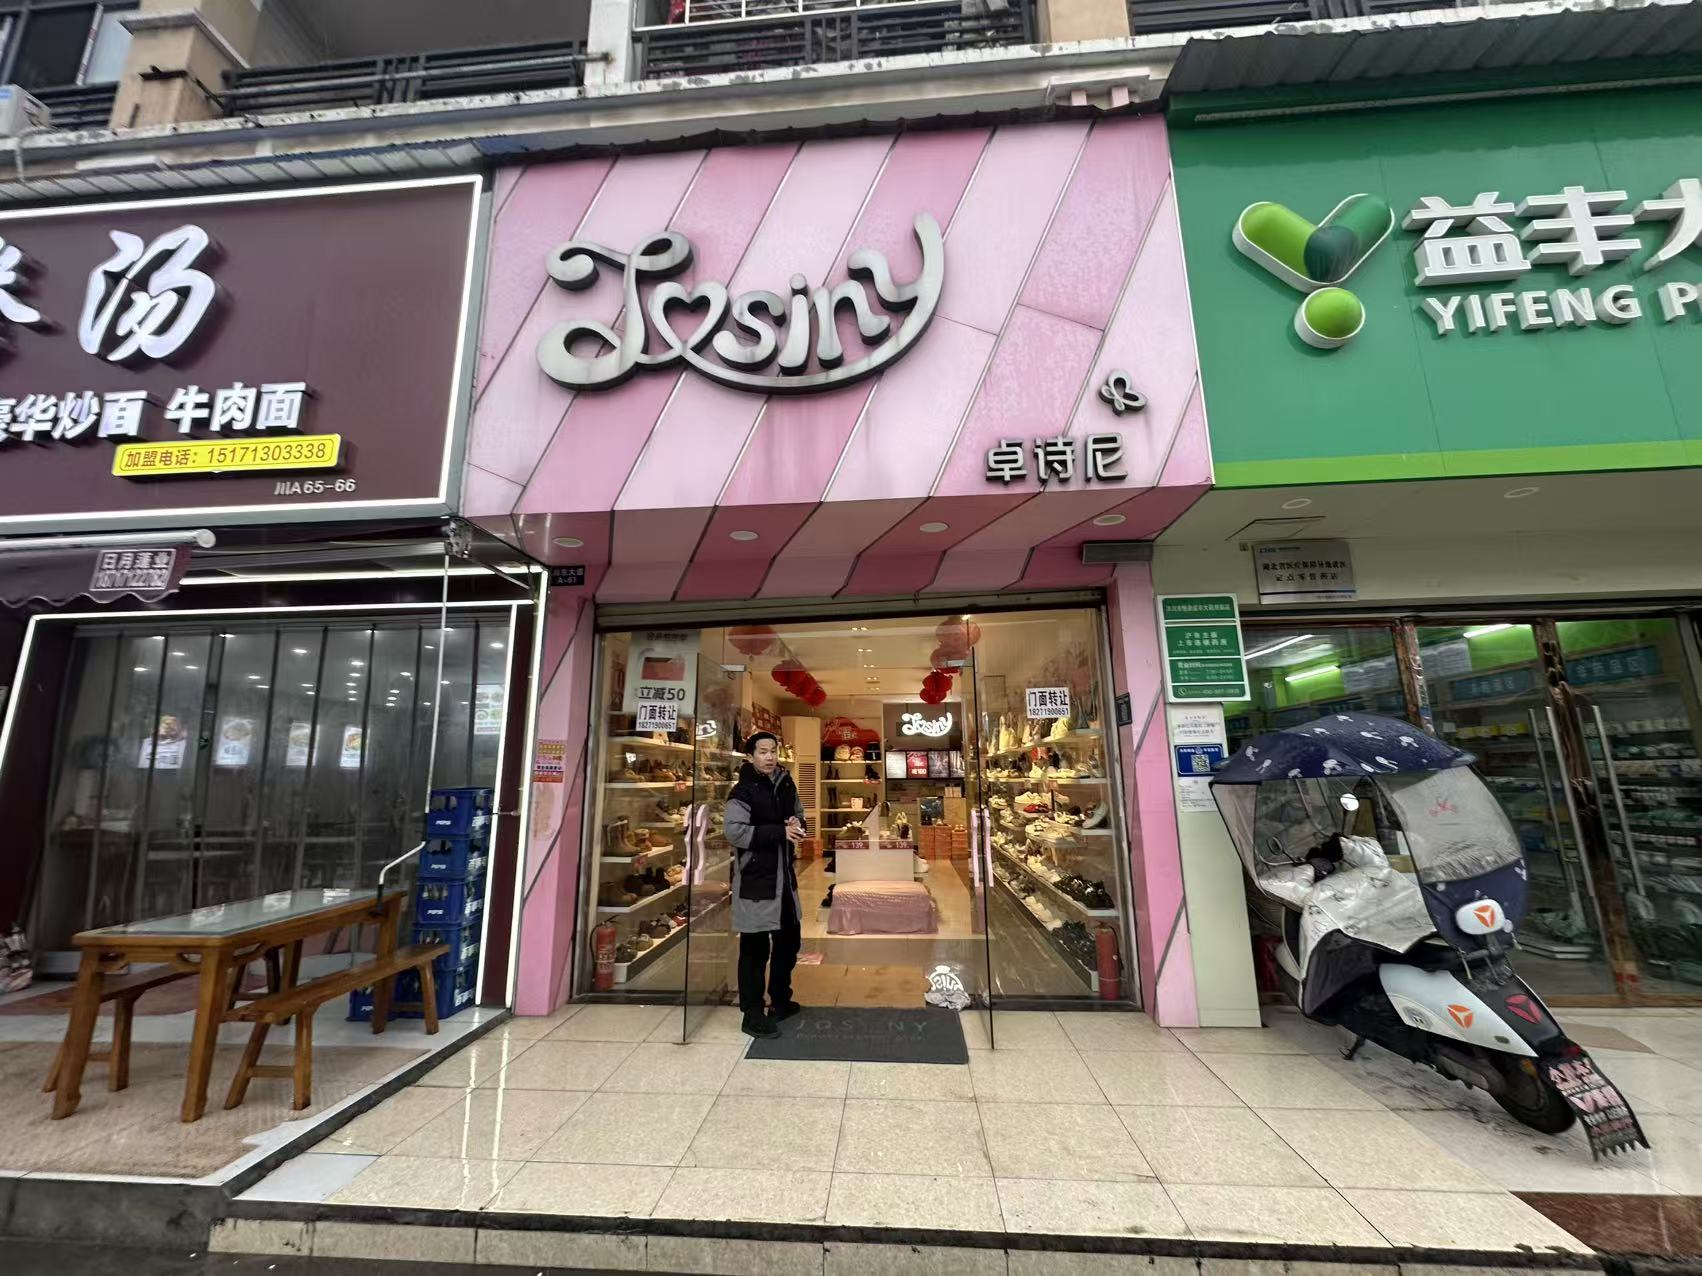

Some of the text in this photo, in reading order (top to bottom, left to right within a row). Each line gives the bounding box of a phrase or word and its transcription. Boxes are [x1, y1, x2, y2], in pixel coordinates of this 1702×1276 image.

[1423, 282, 1702, 334] YIFENG P
[164, 382, 306, 433] 牛肉面
[207, 443, 326, 464] 15171303338
[986, 432, 1128, 485] 卓诗尼
[639, 704, 676, 720] 门面转让
[1028, 690, 1069, 707] 门面转让
